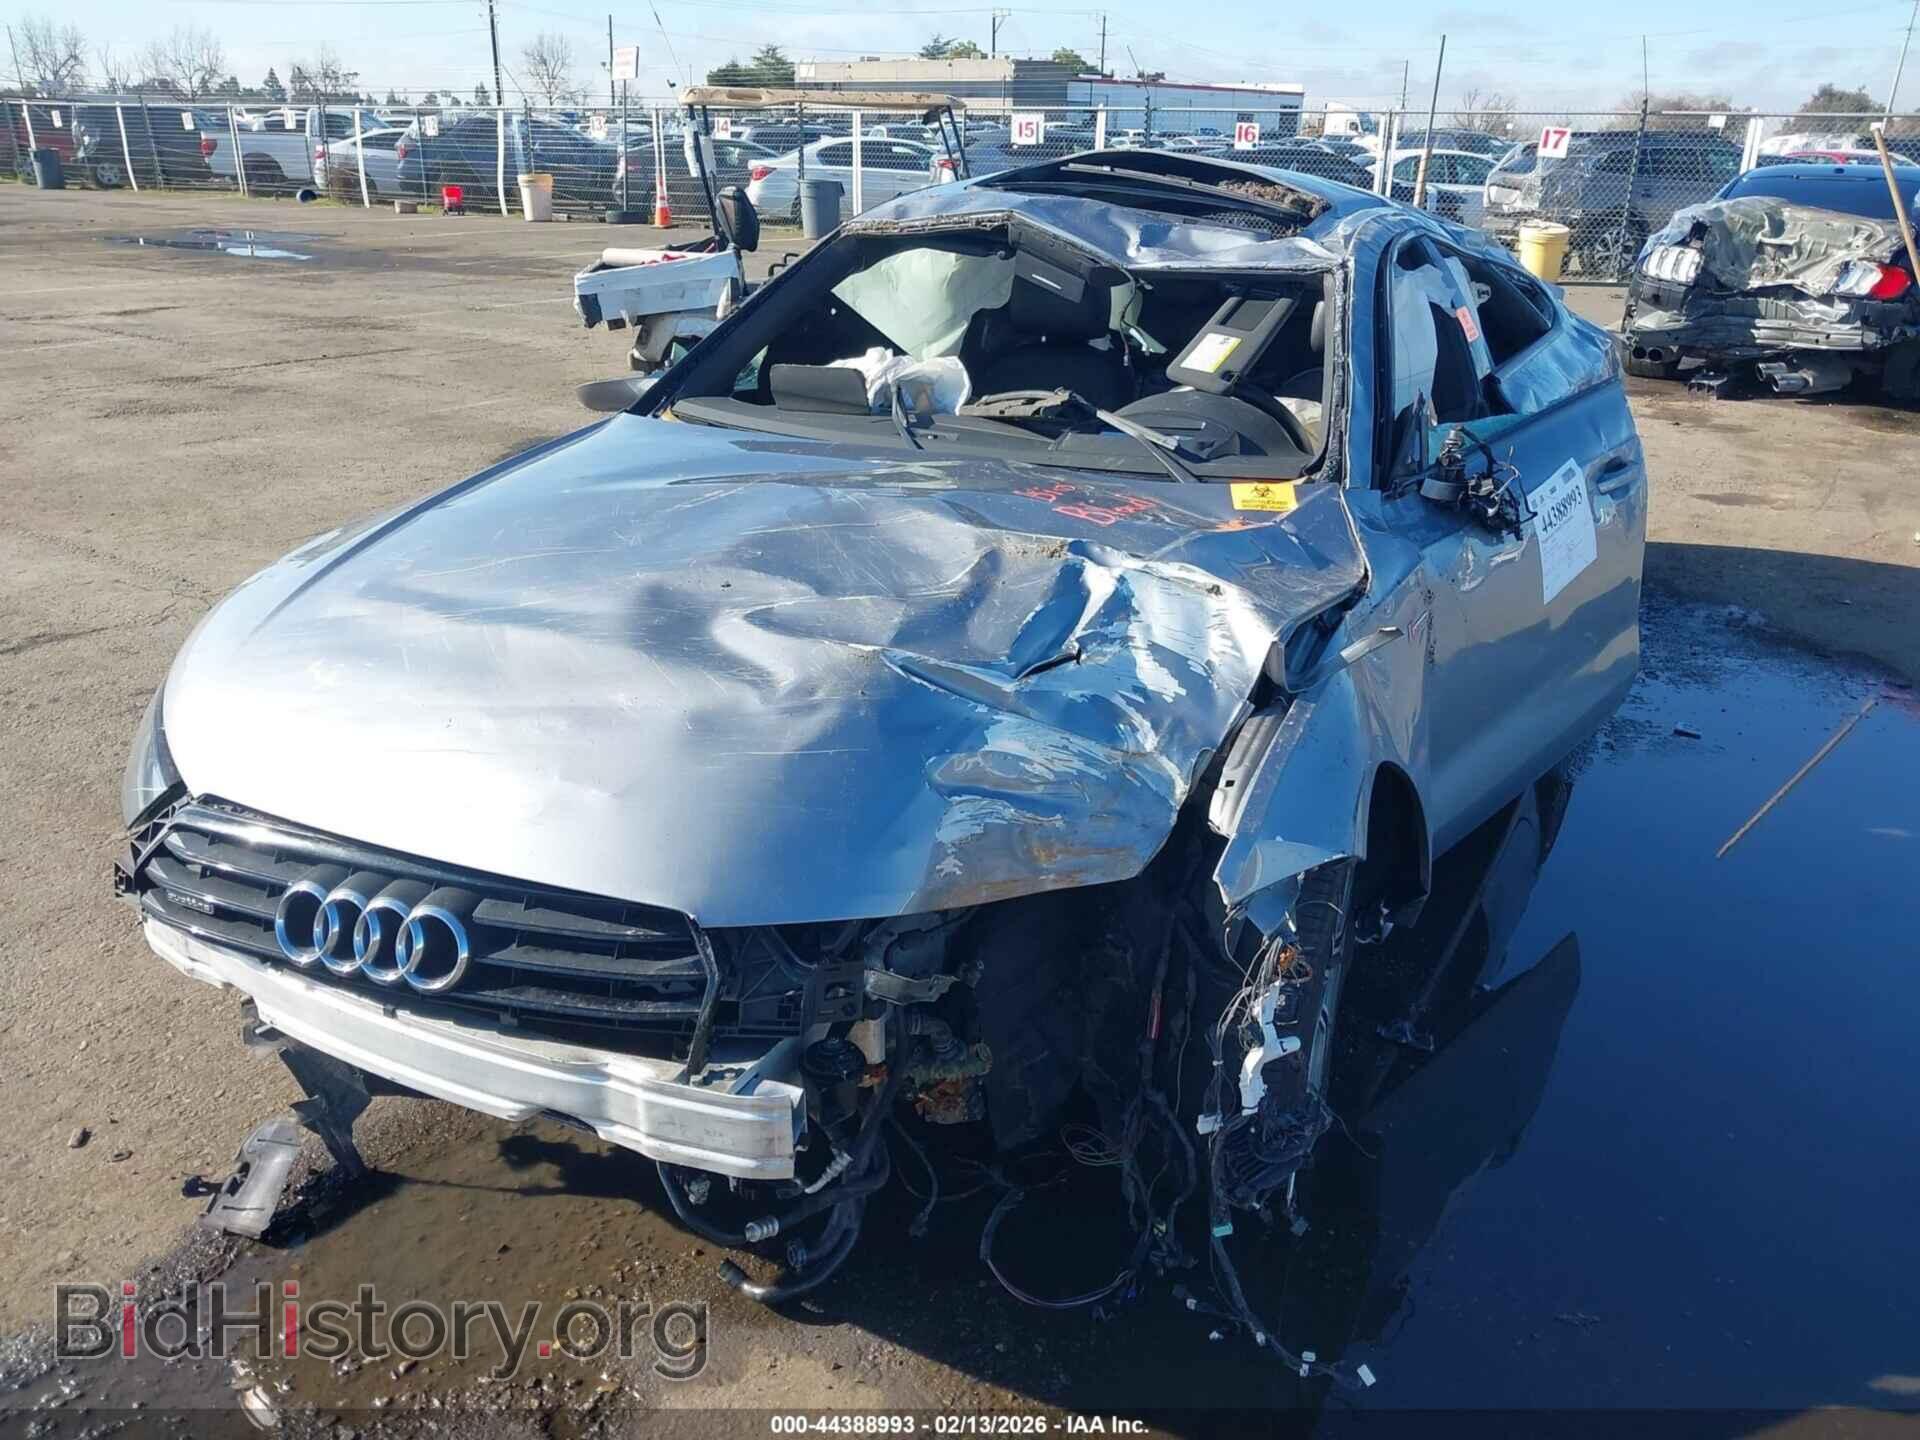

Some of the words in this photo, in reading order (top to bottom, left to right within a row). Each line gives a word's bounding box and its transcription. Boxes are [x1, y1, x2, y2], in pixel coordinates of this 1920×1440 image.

[716, 119, 729, 133] 14
[1018, 121, 1035, 138] 15
[1237, 124, 1257, 143] 16
[1541, 129, 1568, 149] 17
[1541, 484, 1583, 534] 44388993
